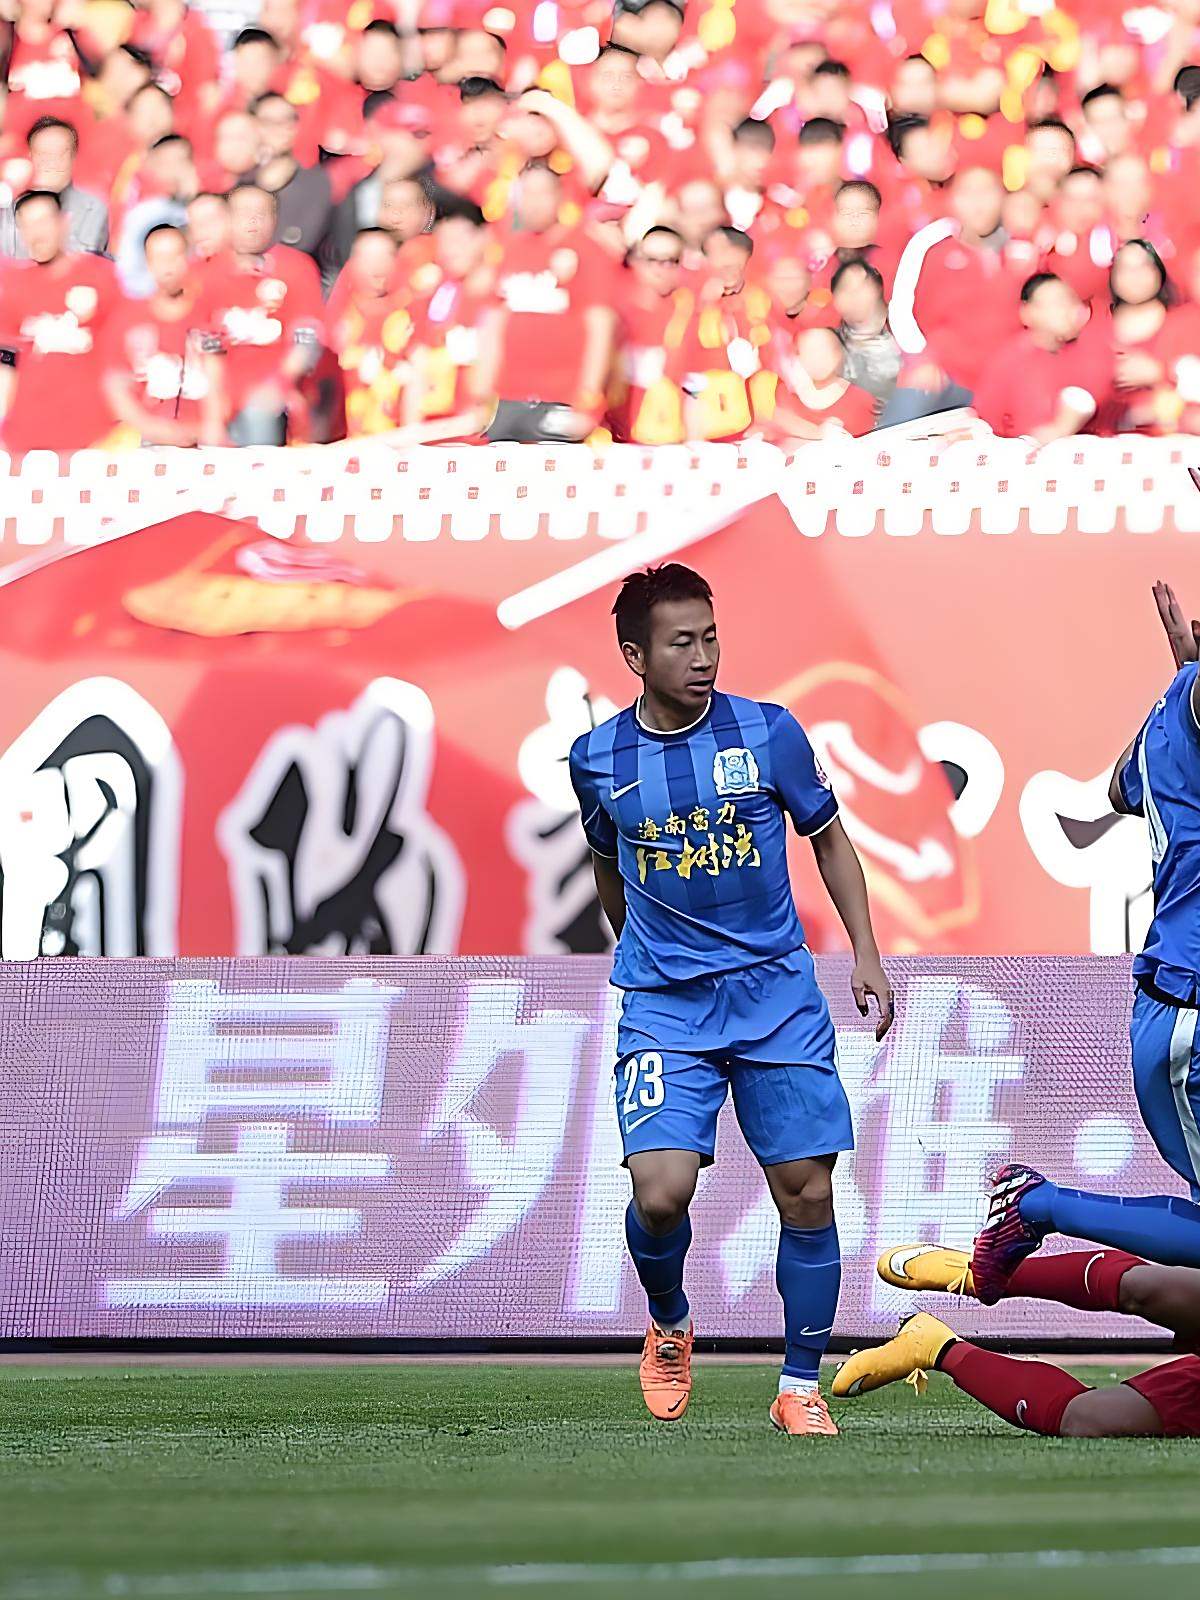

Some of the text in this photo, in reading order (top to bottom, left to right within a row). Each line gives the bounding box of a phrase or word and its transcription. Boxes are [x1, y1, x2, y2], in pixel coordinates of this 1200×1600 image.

[638, 801, 737, 841] 海南富力
[621, 1051, 666, 1115] 23
